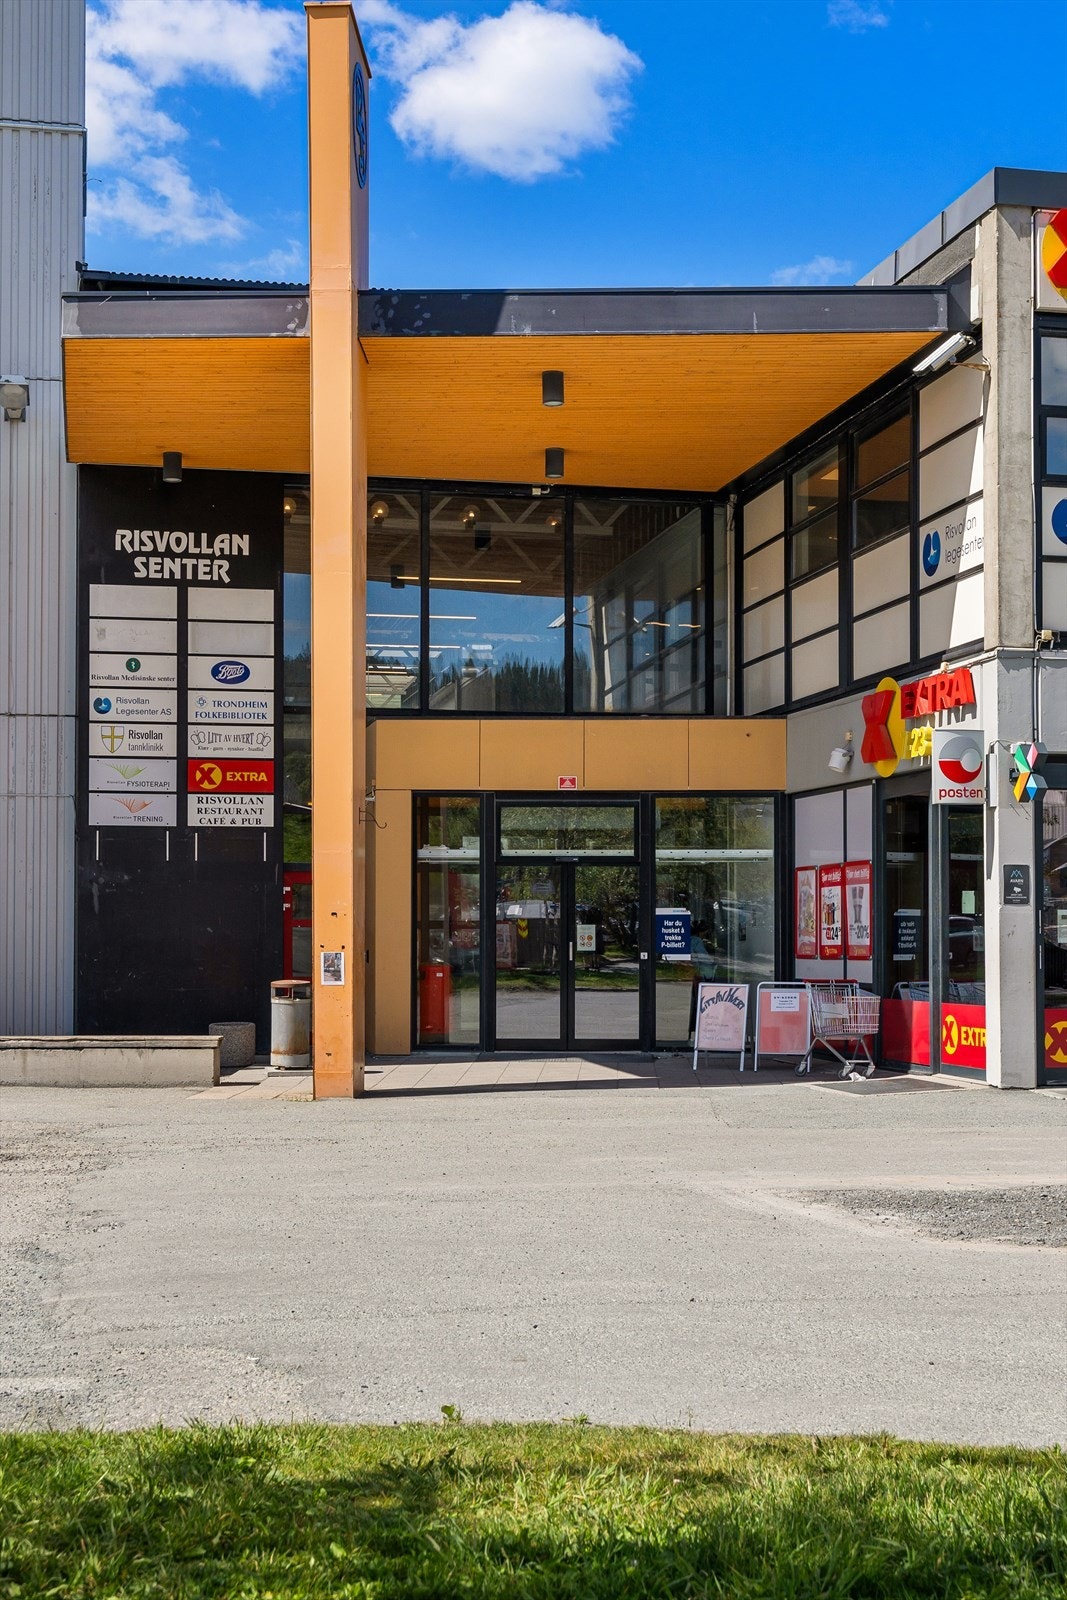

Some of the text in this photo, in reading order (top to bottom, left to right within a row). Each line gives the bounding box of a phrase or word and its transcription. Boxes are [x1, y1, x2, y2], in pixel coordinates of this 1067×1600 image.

[945, 516, 977, 541] Risvollan
[115, 529, 250, 557] RISVOLLAN
[134, 556, 231, 584] SENTER
[215, 664, 245, 680] Boots
[116, 696, 150, 704] Risvollan
[212, 700, 268, 709] TRONDHEIM
[116, 708, 159, 716] Legesenter
[195, 712, 268, 720] FOLKEBIBLIOTEK
[128, 730, 163, 740] Risvollan
[207, 732, 254, 744] LITT AV HVERT
[128, 742, 164, 752] tannklinikk
[226, 772, 268, 782] EXTRA
[938, 786, 983, 801] posten
[196, 796, 264, 805] RISVOLLAN
[199, 816, 226, 825] CAFÉ
